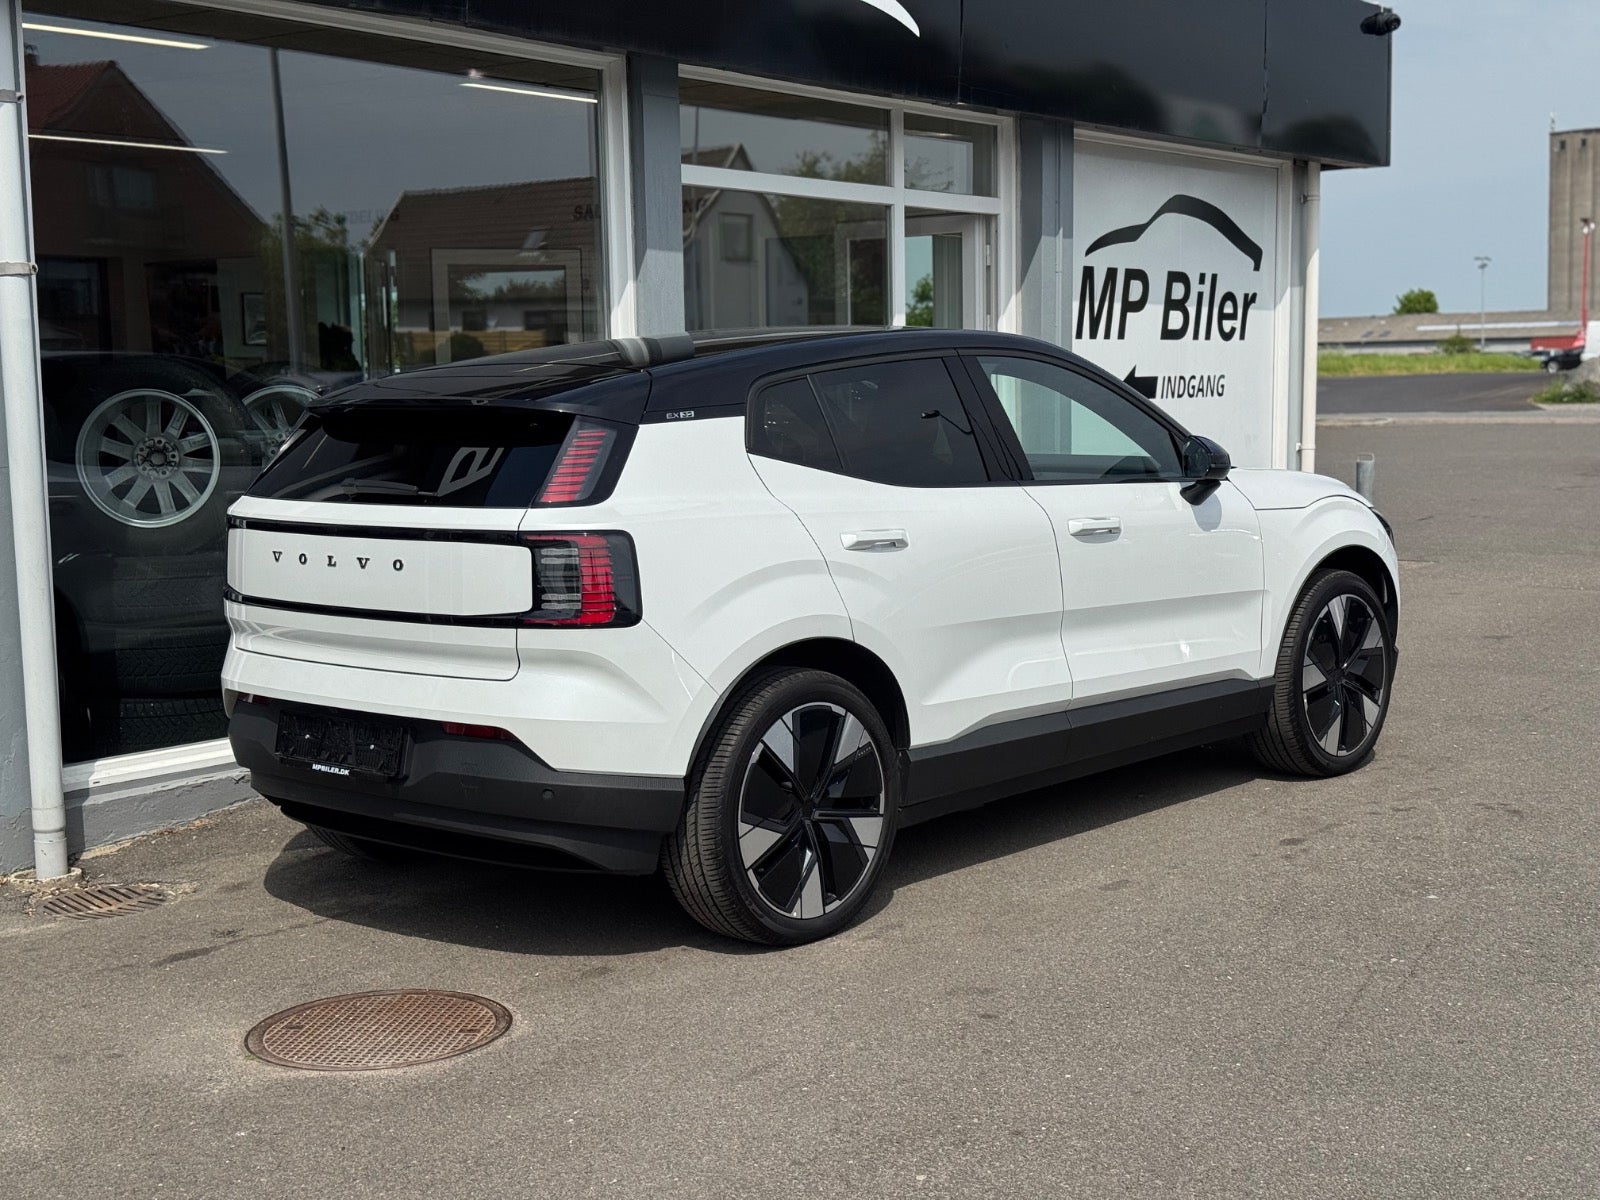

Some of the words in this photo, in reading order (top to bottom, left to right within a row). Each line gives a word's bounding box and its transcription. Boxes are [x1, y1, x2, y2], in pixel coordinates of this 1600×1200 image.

[1075, 265, 1150, 340] MP
[1160, 270, 1258, 342] Biler
[1161, 374, 1226, 400] INDGANG
[272, 550, 404, 572] VOLVO
